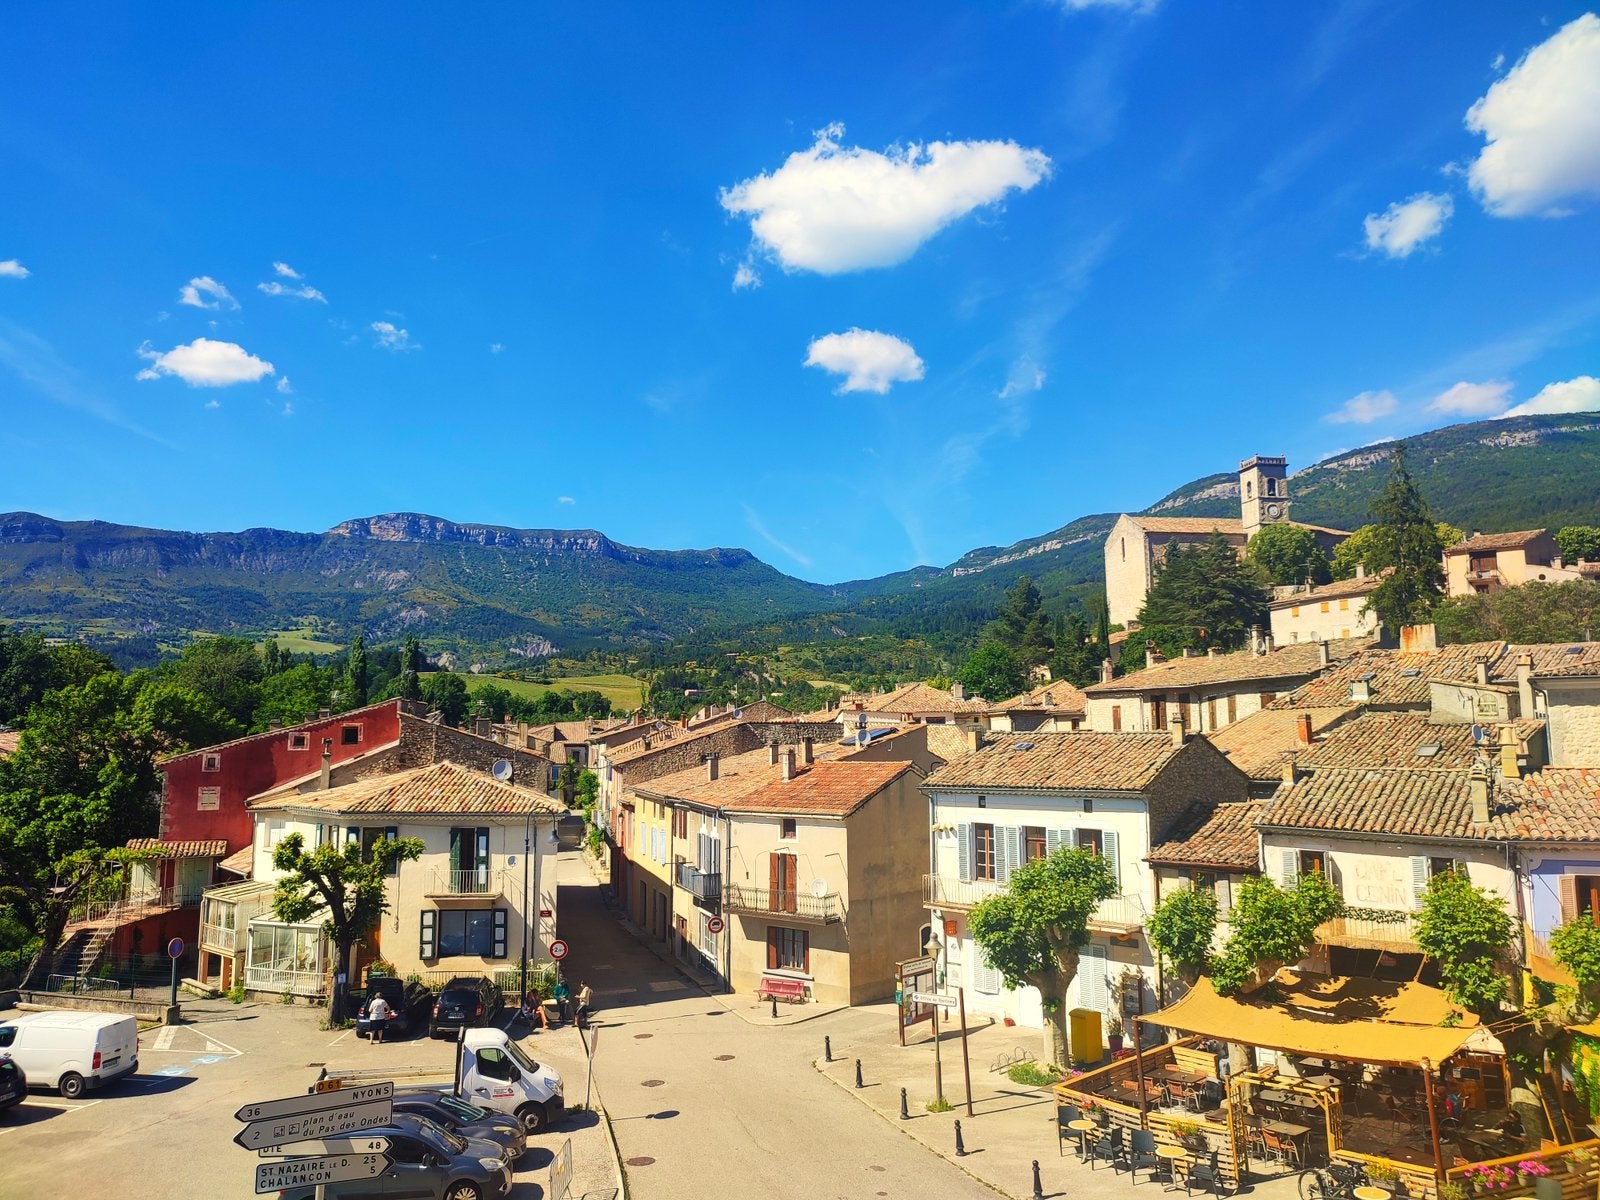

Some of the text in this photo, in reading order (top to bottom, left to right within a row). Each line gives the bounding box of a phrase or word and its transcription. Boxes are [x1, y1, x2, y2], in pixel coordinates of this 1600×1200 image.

[319, 1080, 340, 1091] D 61
[353, 1087, 389, 1100] NYONS
[247, 1108, 260, 1117] 36
[303, 1112, 354, 1128] plan d'eau
[303, 1128, 314, 1136] du
[340, 1121, 356, 1130] des
[361, 1116, 388, 1126] Ondes
[254, 1132, 260, 1140] 2
[363, 1155, 377, 1165] 25
[261, 1166, 274, 1178] ST
[278, 1162, 325, 1174] NAZAIRE
[260, 1172, 331, 1188] CHALANCON
